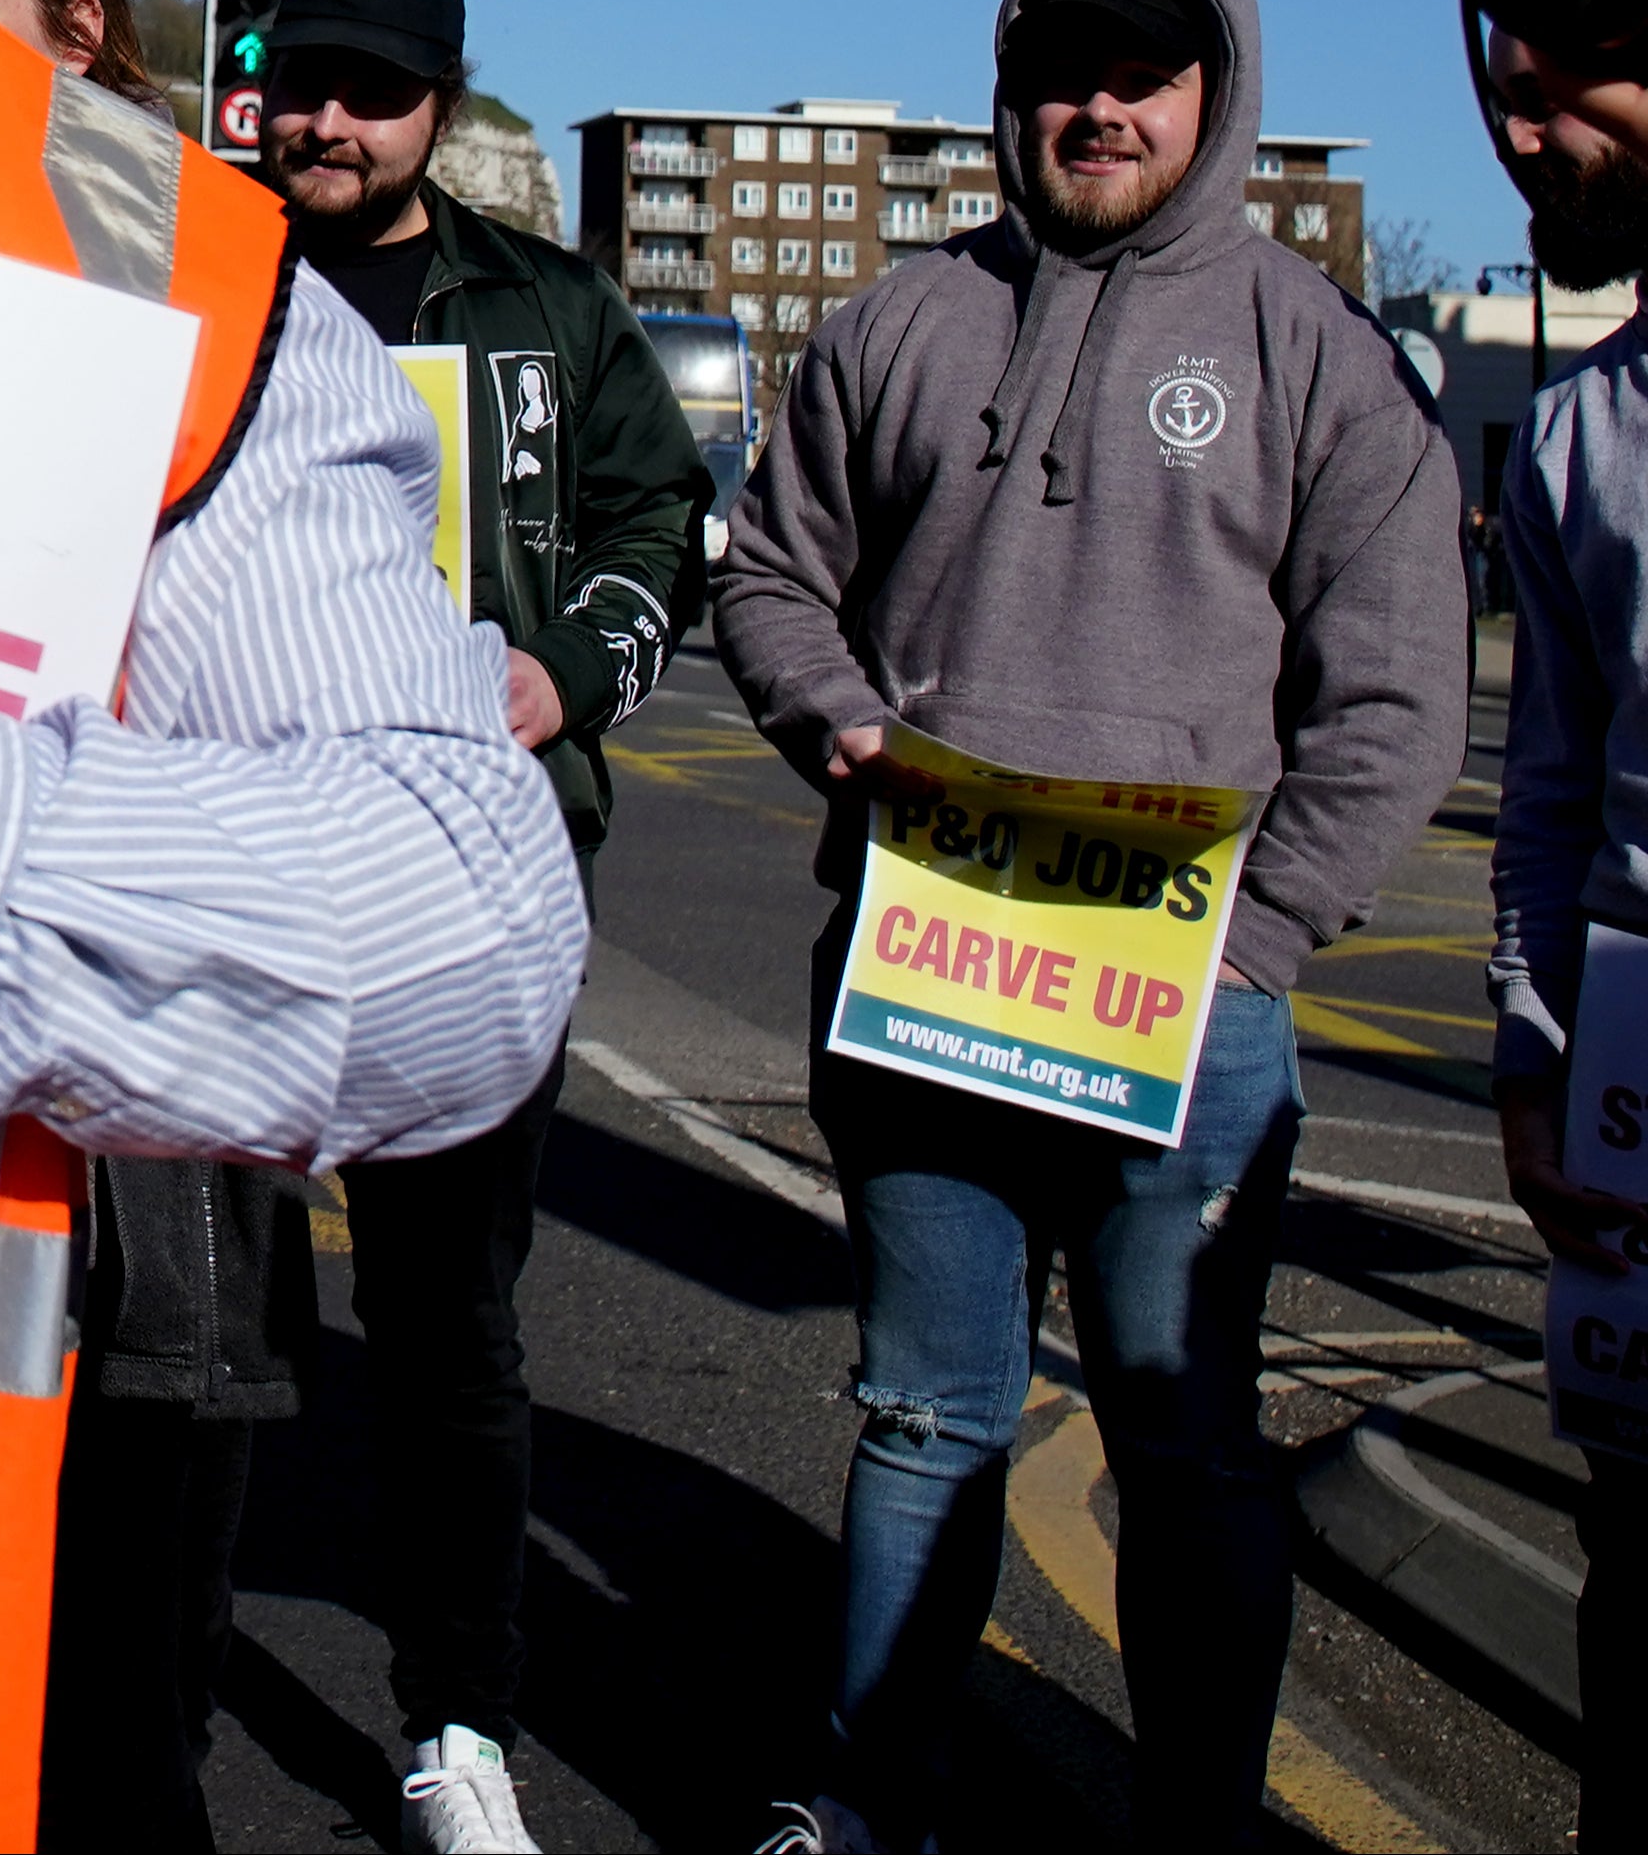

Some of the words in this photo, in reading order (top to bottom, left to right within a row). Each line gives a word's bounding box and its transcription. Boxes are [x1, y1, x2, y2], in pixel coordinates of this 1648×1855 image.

[1148, 368, 1186, 388] DOVER
[1190, 368, 1235, 399] SHIPPING
[1177, 354, 1219, 370] RMT
[1101, 783, 1220, 832] THE
[891, 802, 1020, 871] P&O
[1035, 830, 1212, 922] JOBS
[875, 905, 1077, 1013] CARVE
[1093, 965, 1185, 1037] UP
[886, 1015, 1132, 1106] www.rmt.org.uk
